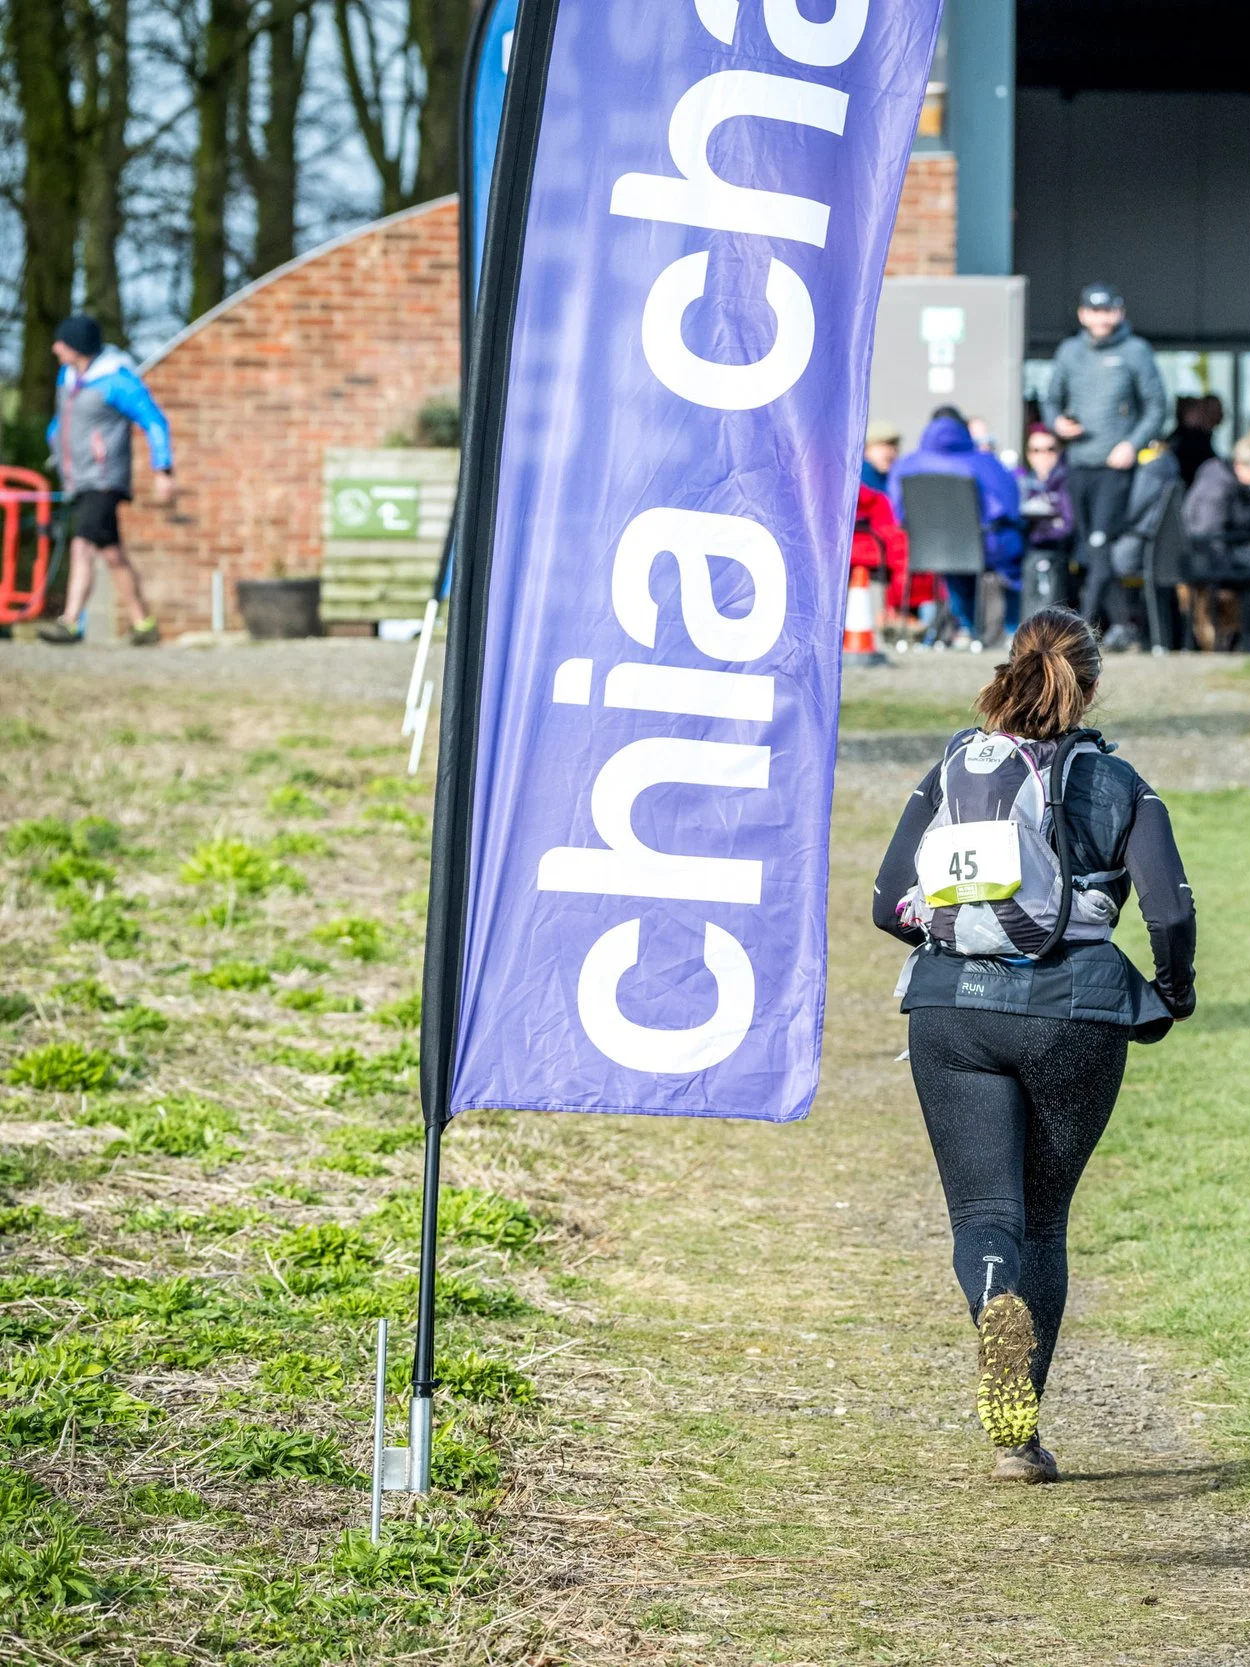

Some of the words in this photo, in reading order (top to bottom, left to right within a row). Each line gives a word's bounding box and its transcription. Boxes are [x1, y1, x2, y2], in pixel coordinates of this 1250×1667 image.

[538, 507, 787, 1074] chia
[949, 850, 978, 881] 45
[962, 982, 985, 993] RUN
